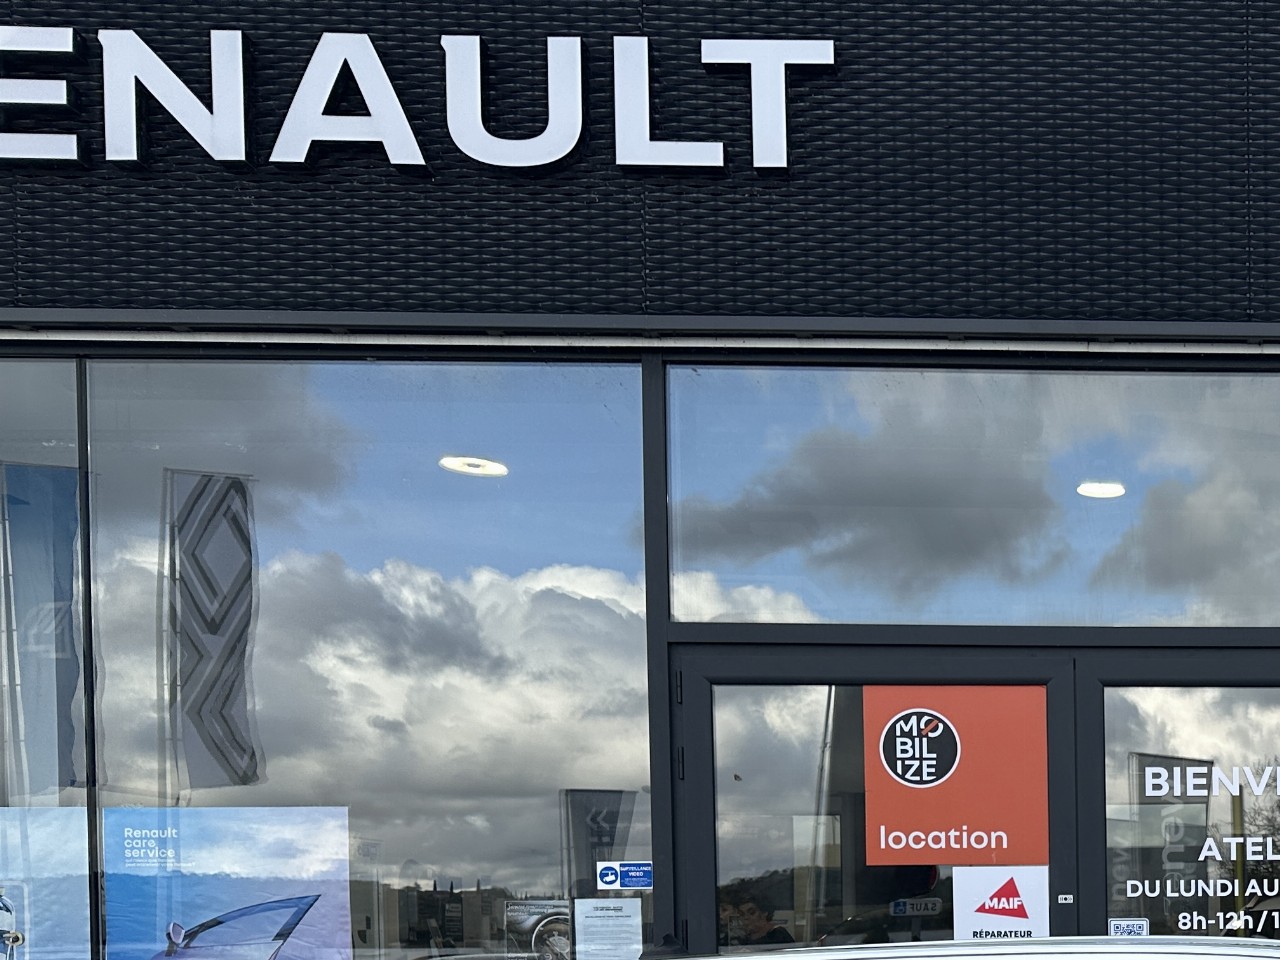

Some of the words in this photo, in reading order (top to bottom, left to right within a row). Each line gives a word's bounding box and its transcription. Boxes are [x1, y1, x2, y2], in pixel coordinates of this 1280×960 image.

[124, 827, 178, 838] Renault
[880, 825, 1008, 850] location
[124, 839, 156, 848] care
[124, 846, 176, 858] service
[1126, 879, 1160, 898] DU
[1166, 879, 1240, 897] LUNDI
[1244, 878, 1280, 897] AU
[984, 897, 1023, 910] MAIF
[972, 930, 1033, 939] RÉPARATEUR
